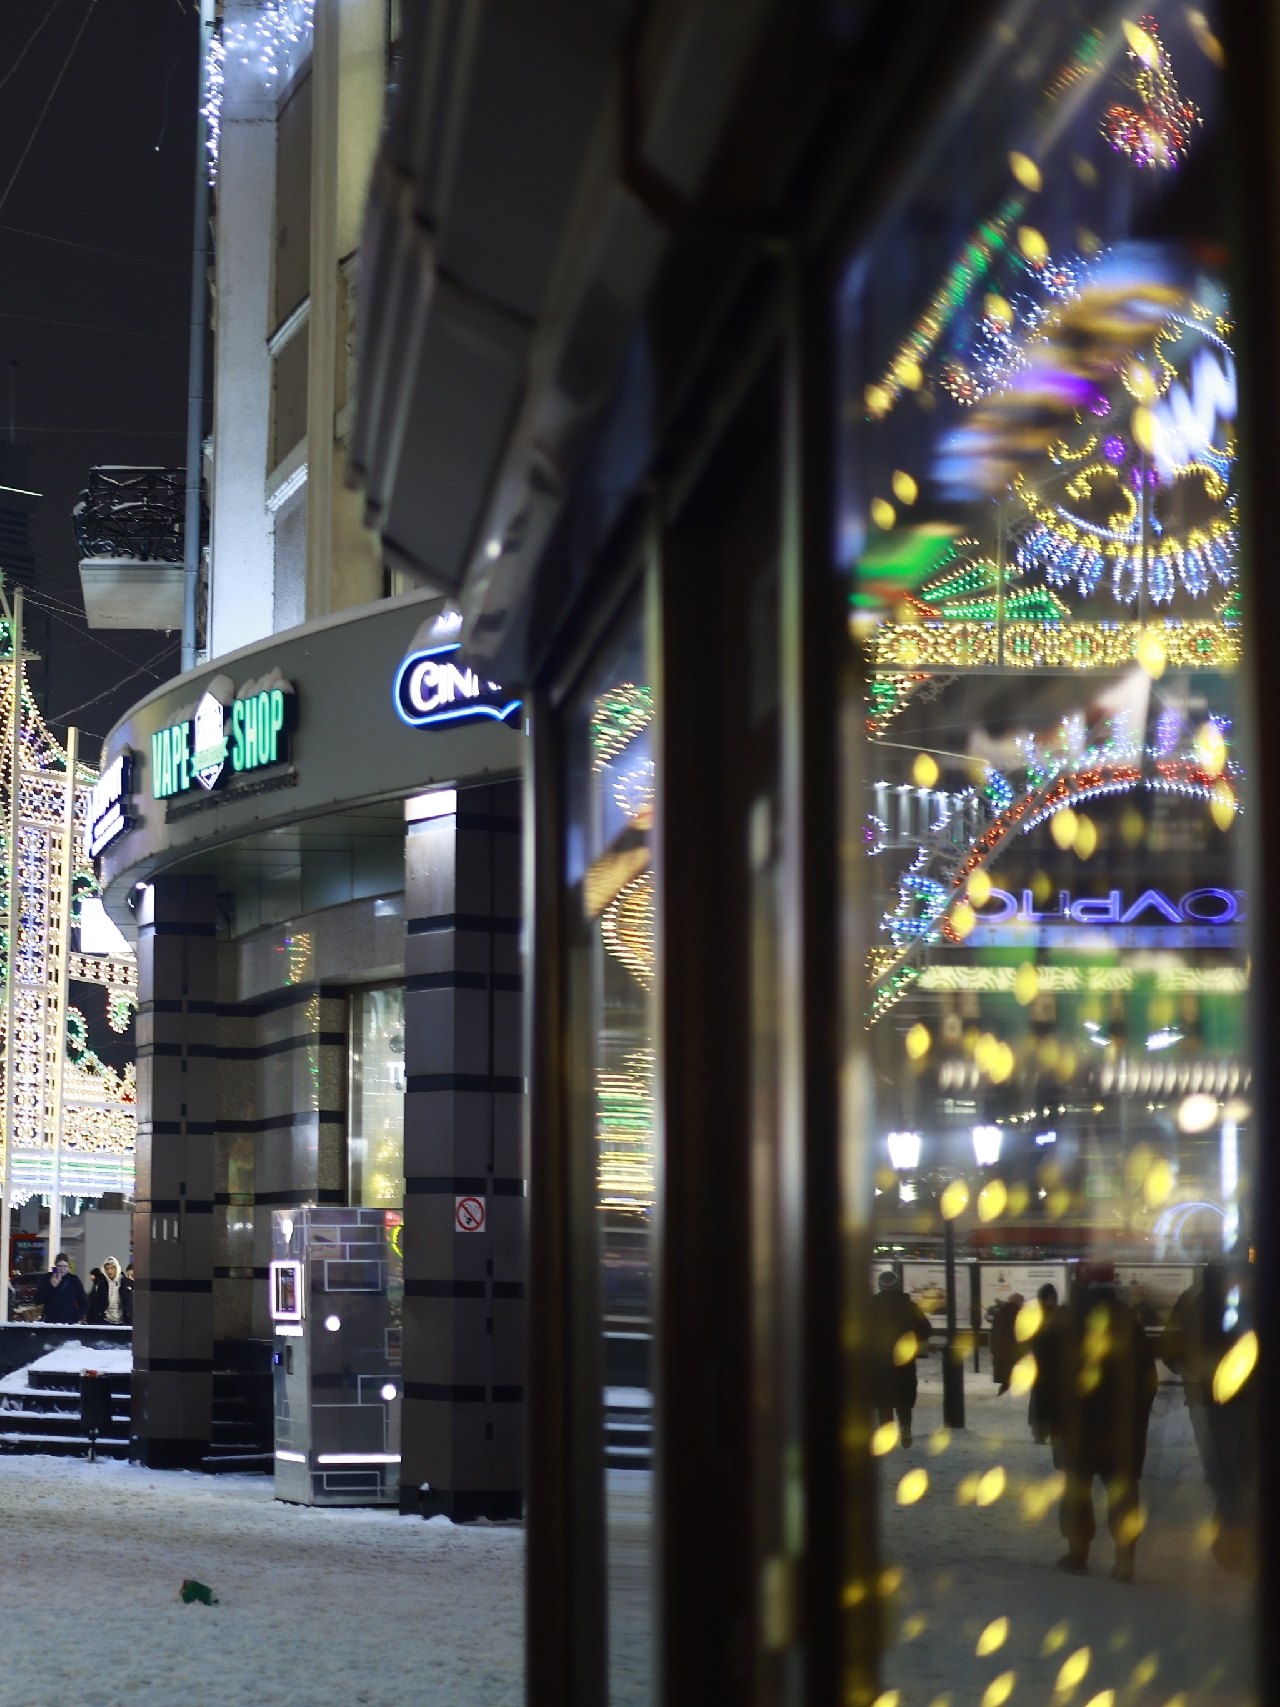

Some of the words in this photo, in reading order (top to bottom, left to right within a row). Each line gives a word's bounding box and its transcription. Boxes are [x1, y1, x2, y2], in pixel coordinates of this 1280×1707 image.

[410, 661, 502, 712] CIN
[152, 721, 190, 799] VAPE
[232, 689, 285, 772] SHOP
